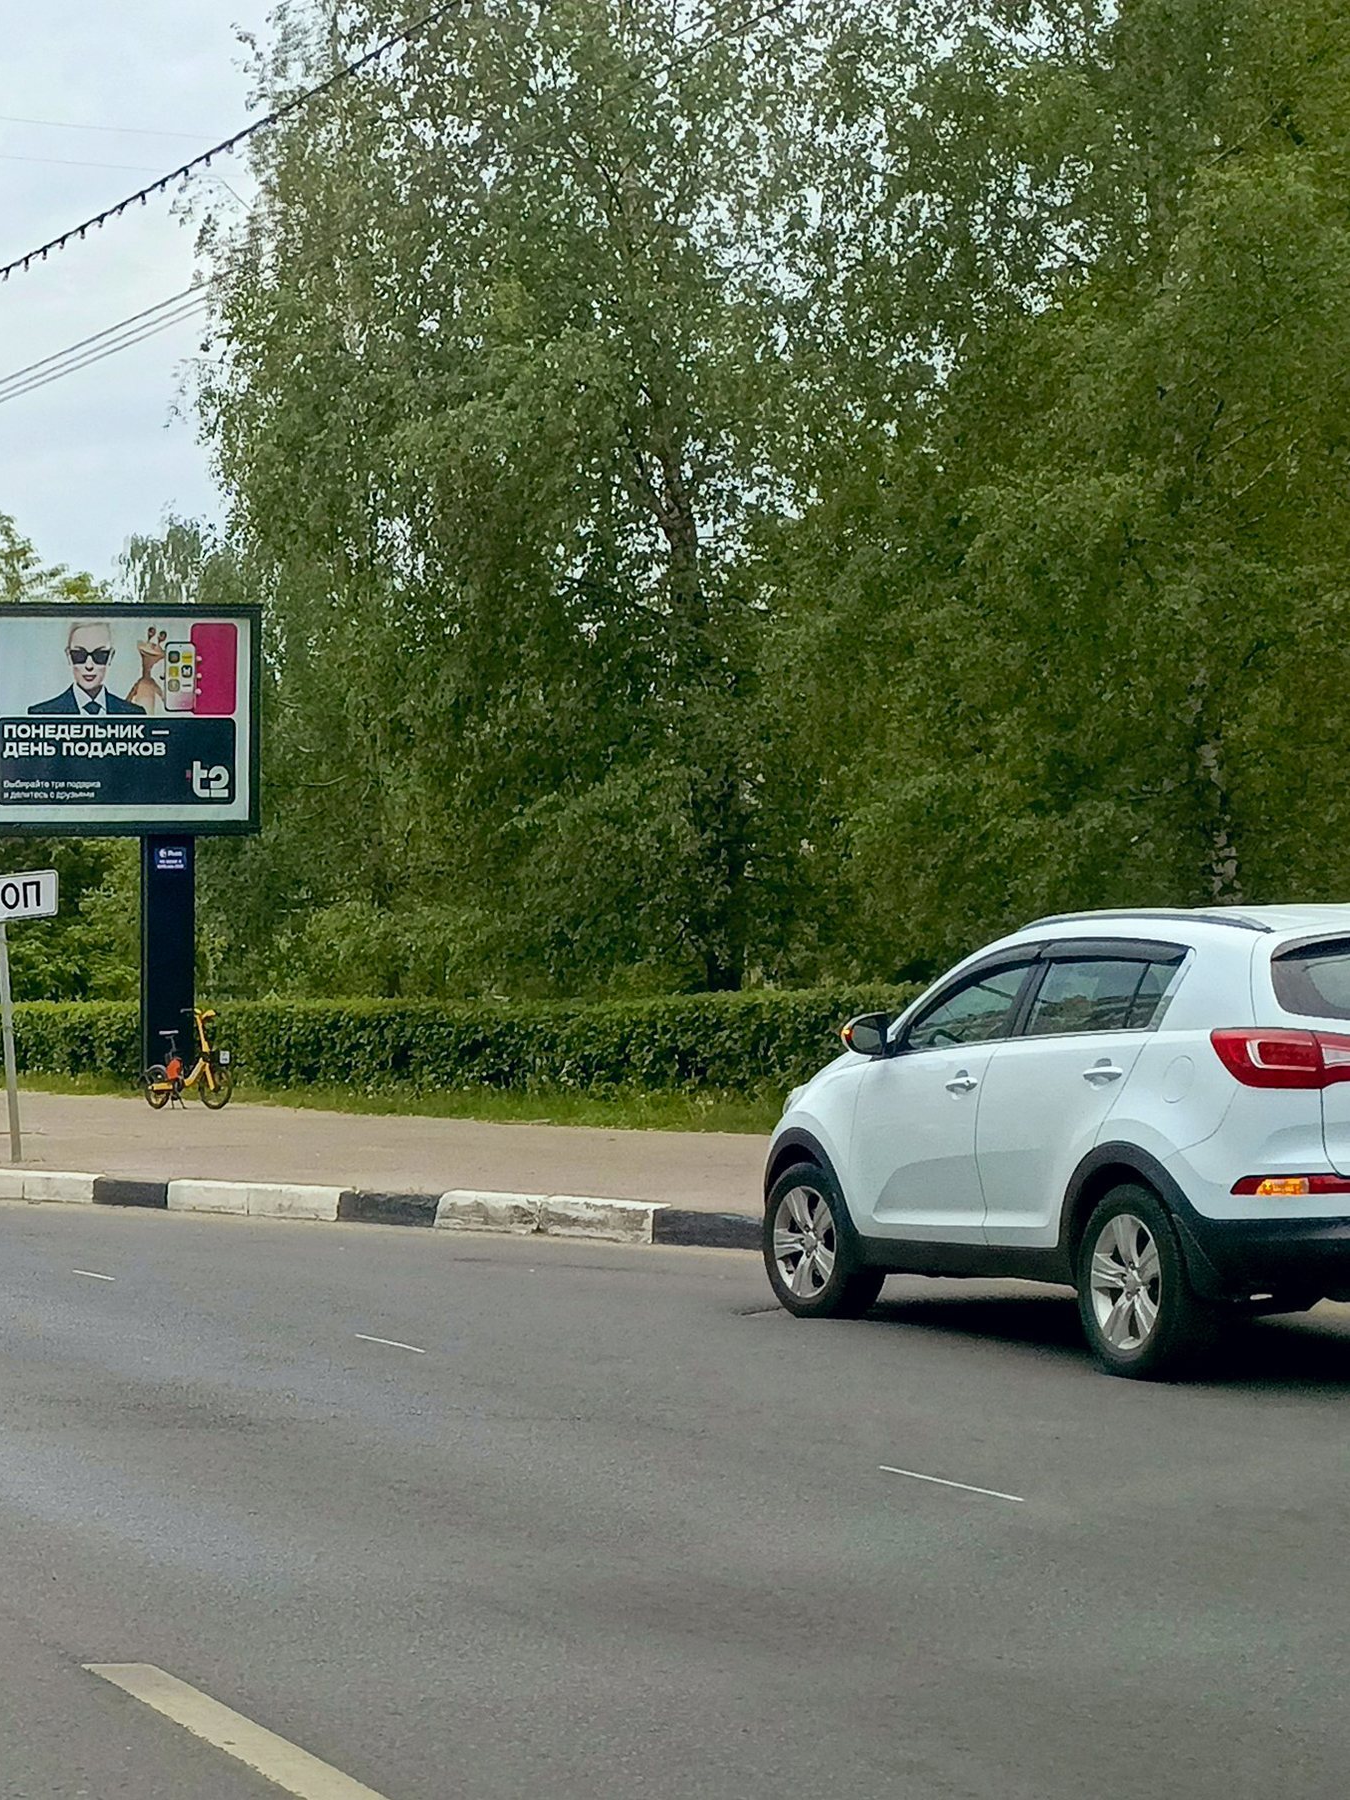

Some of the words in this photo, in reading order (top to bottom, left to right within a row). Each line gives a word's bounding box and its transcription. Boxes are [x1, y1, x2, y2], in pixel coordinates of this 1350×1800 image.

[3, 724, 145, 741] ПОНЕДЕЛЬНИК
[2, 741, 56, 758] ДЕНЬ
[61, 741, 167, 758] ПОДАРКОВ
[192, 760, 229, 798] t2
